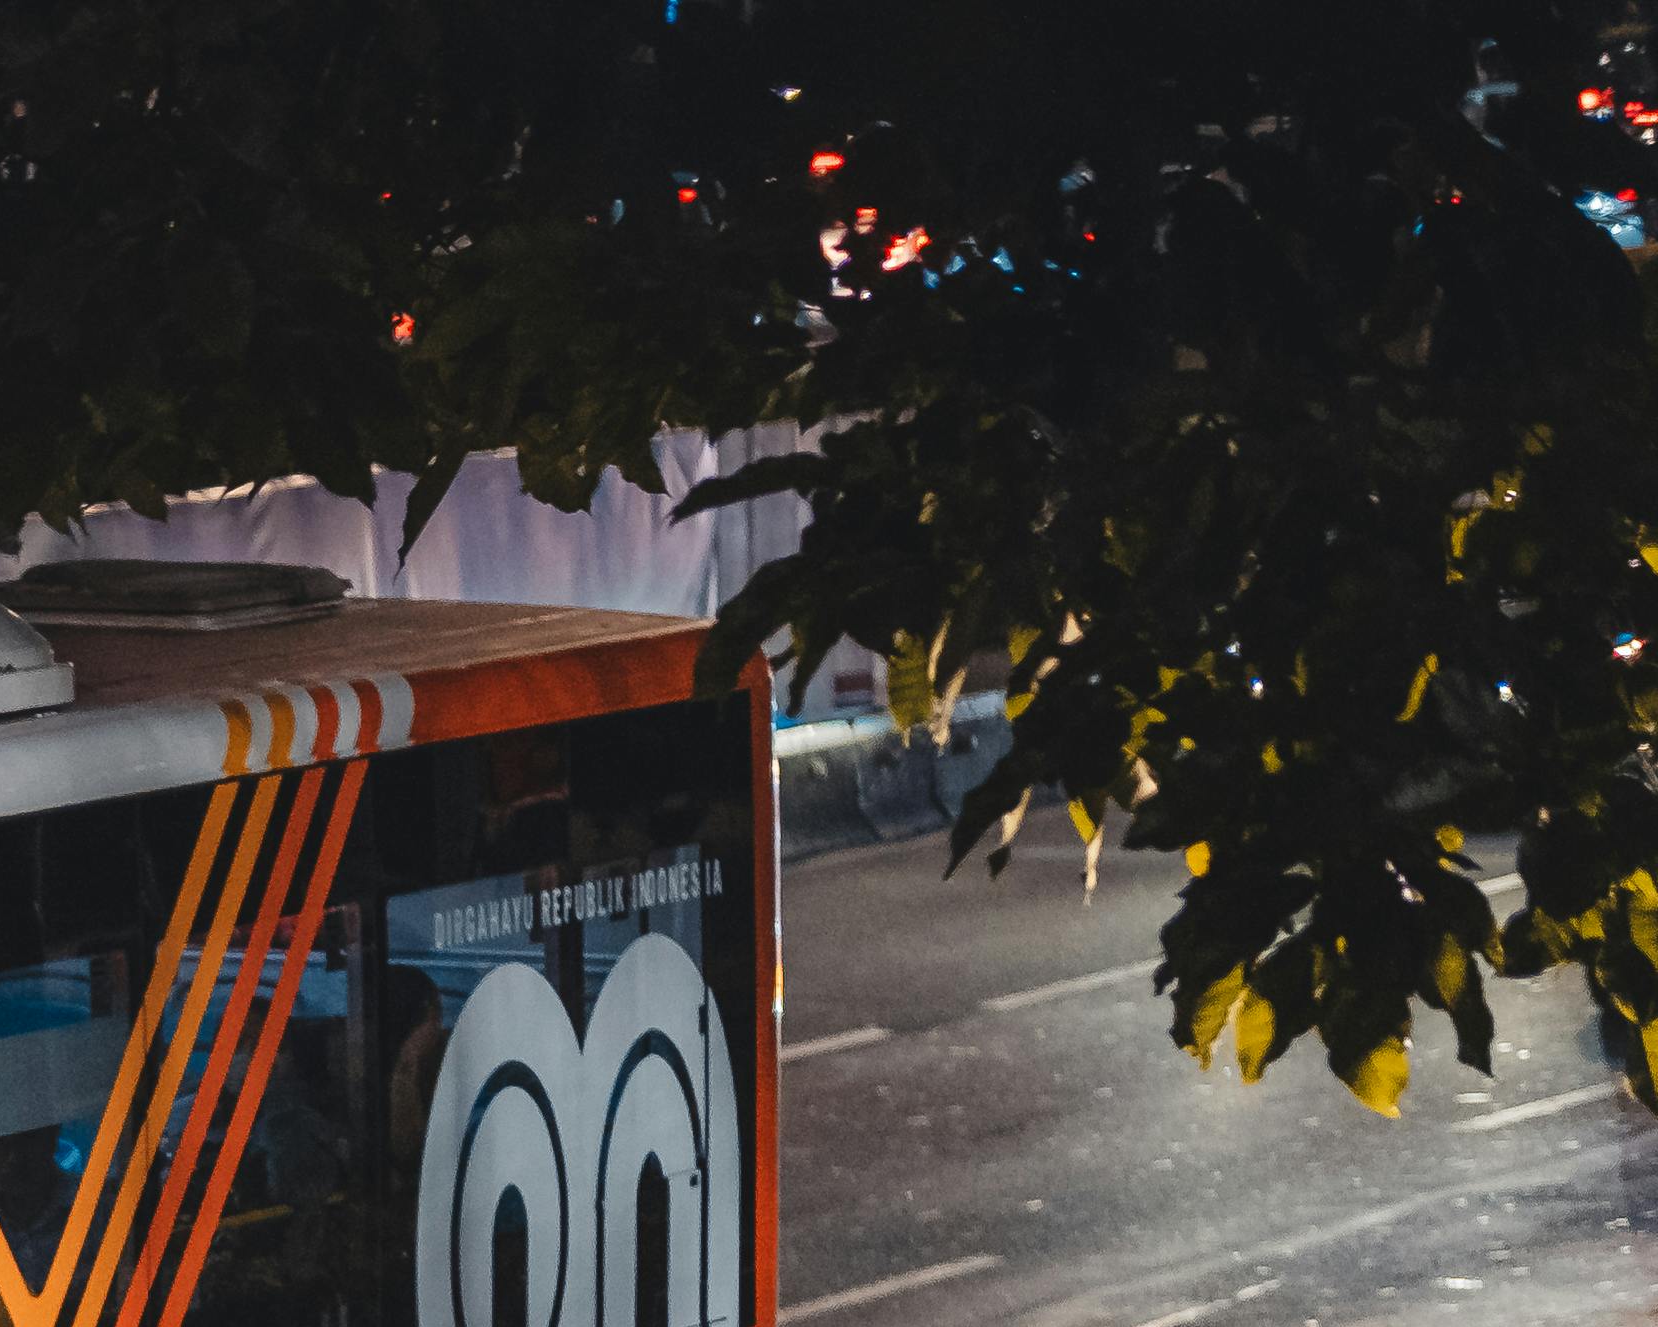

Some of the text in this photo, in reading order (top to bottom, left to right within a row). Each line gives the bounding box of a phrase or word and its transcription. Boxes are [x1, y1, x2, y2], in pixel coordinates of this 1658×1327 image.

[433, 859, 723, 950] DIRGAHAYU REPUBLIK INDONESIA
